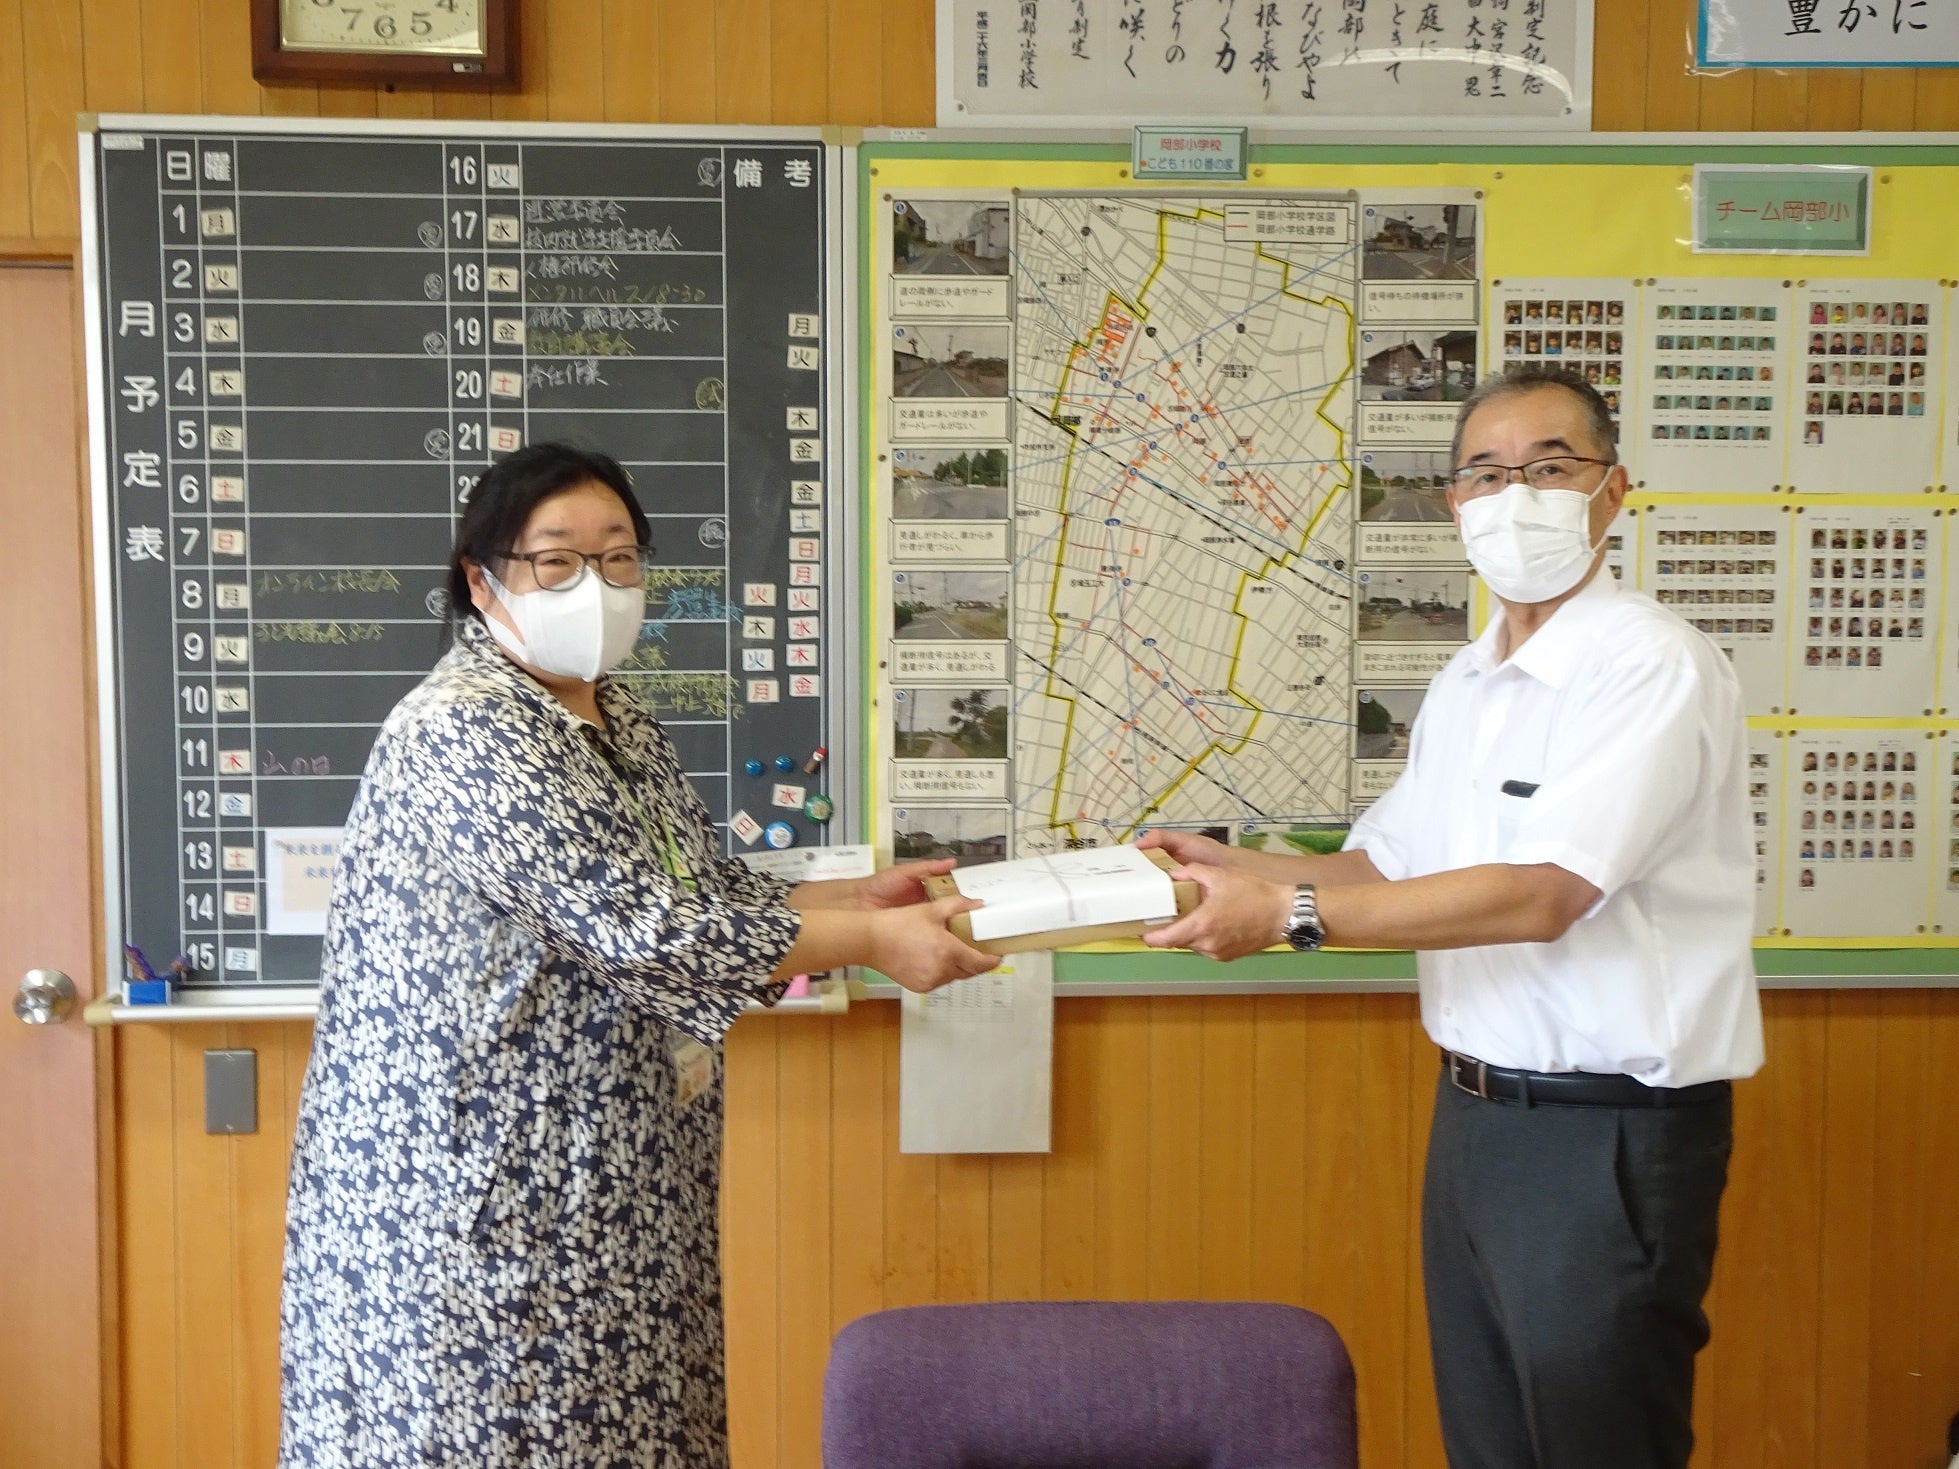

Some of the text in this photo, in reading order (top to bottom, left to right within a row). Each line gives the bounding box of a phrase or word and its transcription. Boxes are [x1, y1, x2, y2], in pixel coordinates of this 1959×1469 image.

[341, 8, 364, 31] 7
[374, 15, 397, 39] 6
[411, 12, 432, 36] 5
[1783, 0, 1928, 36] 豊かに
[1160, 138, 1222, 151] 岡部小学校
[167, 151, 231, 181] 日 曜
[450, 156, 512, 186] 16 火
[733, 159, 812, 191] 備考
[173, 204, 186, 233] 1
[1716, 201, 1850, 222] チーム岡部小
[451, 211, 479, 240] 17
[493, 221, 512, 240] 水
[171, 259, 230, 289] 2 火
[453, 264, 512, 292] 18 木
[173, 312, 230, 343] 3 水
[453, 317, 517, 346] 19 金
[793, 317, 812, 335] 月
[793, 349, 812, 366] 火
[174, 366, 234, 397] 4 木
[455, 371, 514, 400] 20 土
[792, 409, 808, 427] 木
[177, 420, 199, 450] 5
[457, 423, 515, 450] 21 日
[794, 441, 812, 460] 金
[179, 474, 235, 504] 6 土
[795, 483, 815, 502] 金
[795, 511, 813, 529] 土
[180, 527, 235, 556] 7 日
[799, 540, 814, 559] 日
[795, 565, 812, 583] 月
[183, 580, 203, 609] 8
[750, 586, 769, 604] 火
[795, 591, 812, 608] 火
[749, 620, 767, 637] 木
[793, 618, 811, 636] 水
[183, 632, 239, 662] 9 火
[747, 652, 766, 669] 火
[791, 646, 809, 663] 木
[752, 682, 770, 699] 月
[794, 676, 812, 694] 金
[181, 685, 209, 715] 10
[182, 738, 243, 770] 11 木
[183, 789, 212, 819] 12
[779, 788, 797, 805] 水
[184, 842, 247, 871] 13 土
[186, 893, 215, 923] 14
[187, 943, 215, 971] 15
